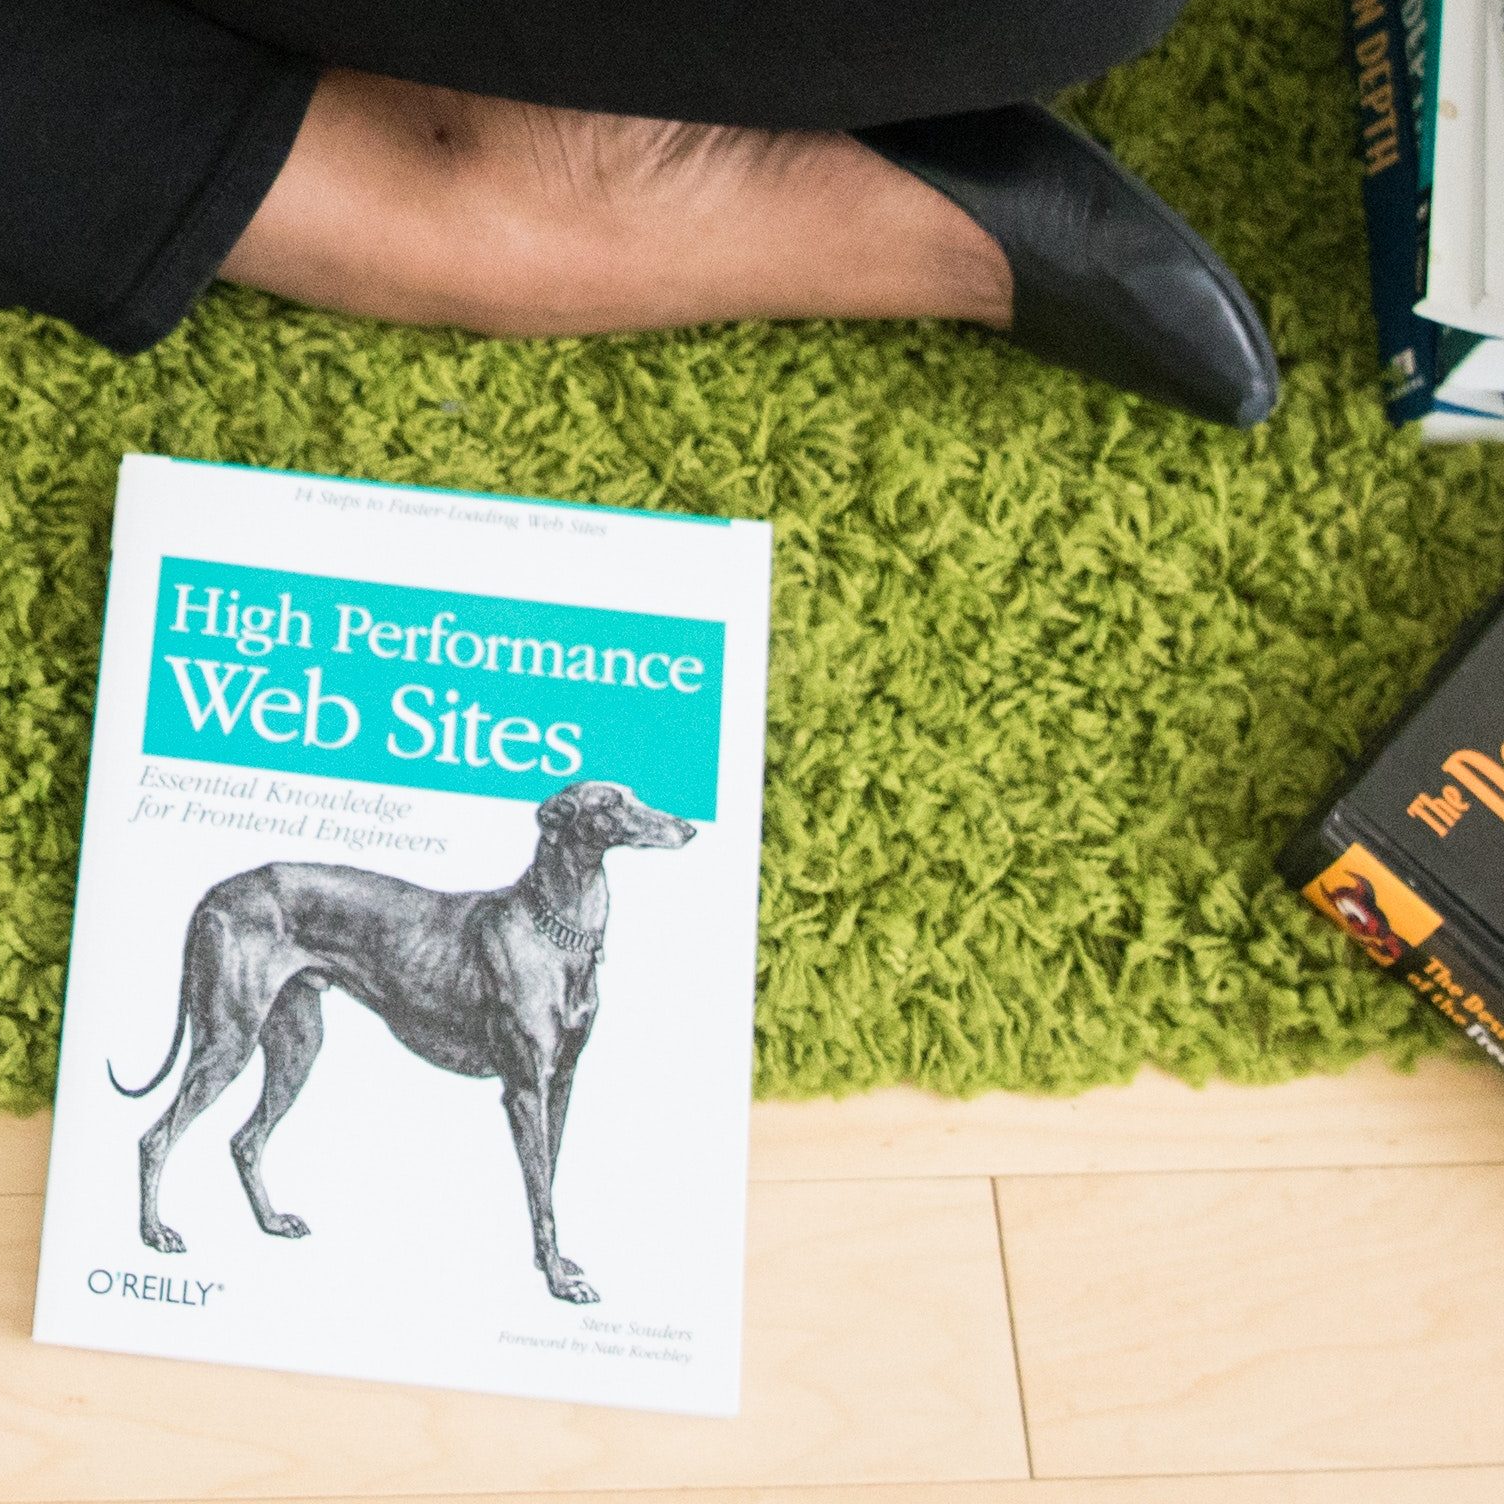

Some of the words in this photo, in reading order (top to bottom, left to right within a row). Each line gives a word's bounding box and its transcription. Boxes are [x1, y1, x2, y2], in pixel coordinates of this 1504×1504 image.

[1354, 36, 1401, 176] DEPTH
[319, 489, 361, 512] Steps
[365, 496, 384, 511] to
[387, 497, 520, 530] Faster-Loading
[527, 512, 564, 530] Web
[569, 518, 608, 537] Sites
[169, 583, 312, 656] High
[332, 603, 709, 696] Performance
[164, 654, 361, 750] Web
[386, 683, 583, 777] Sites
[126, 792, 176, 824] for
[180, 800, 309, 837] Frontend
[313, 817, 446, 853] Engineers
[137, 763, 259, 800] Essential
[264, 780, 413, 823] Knowledge
[1405, 783, 1470, 838] The
[1423, 955, 1464, 997] The
[86, 1267, 214, 1306] O'REILLY
